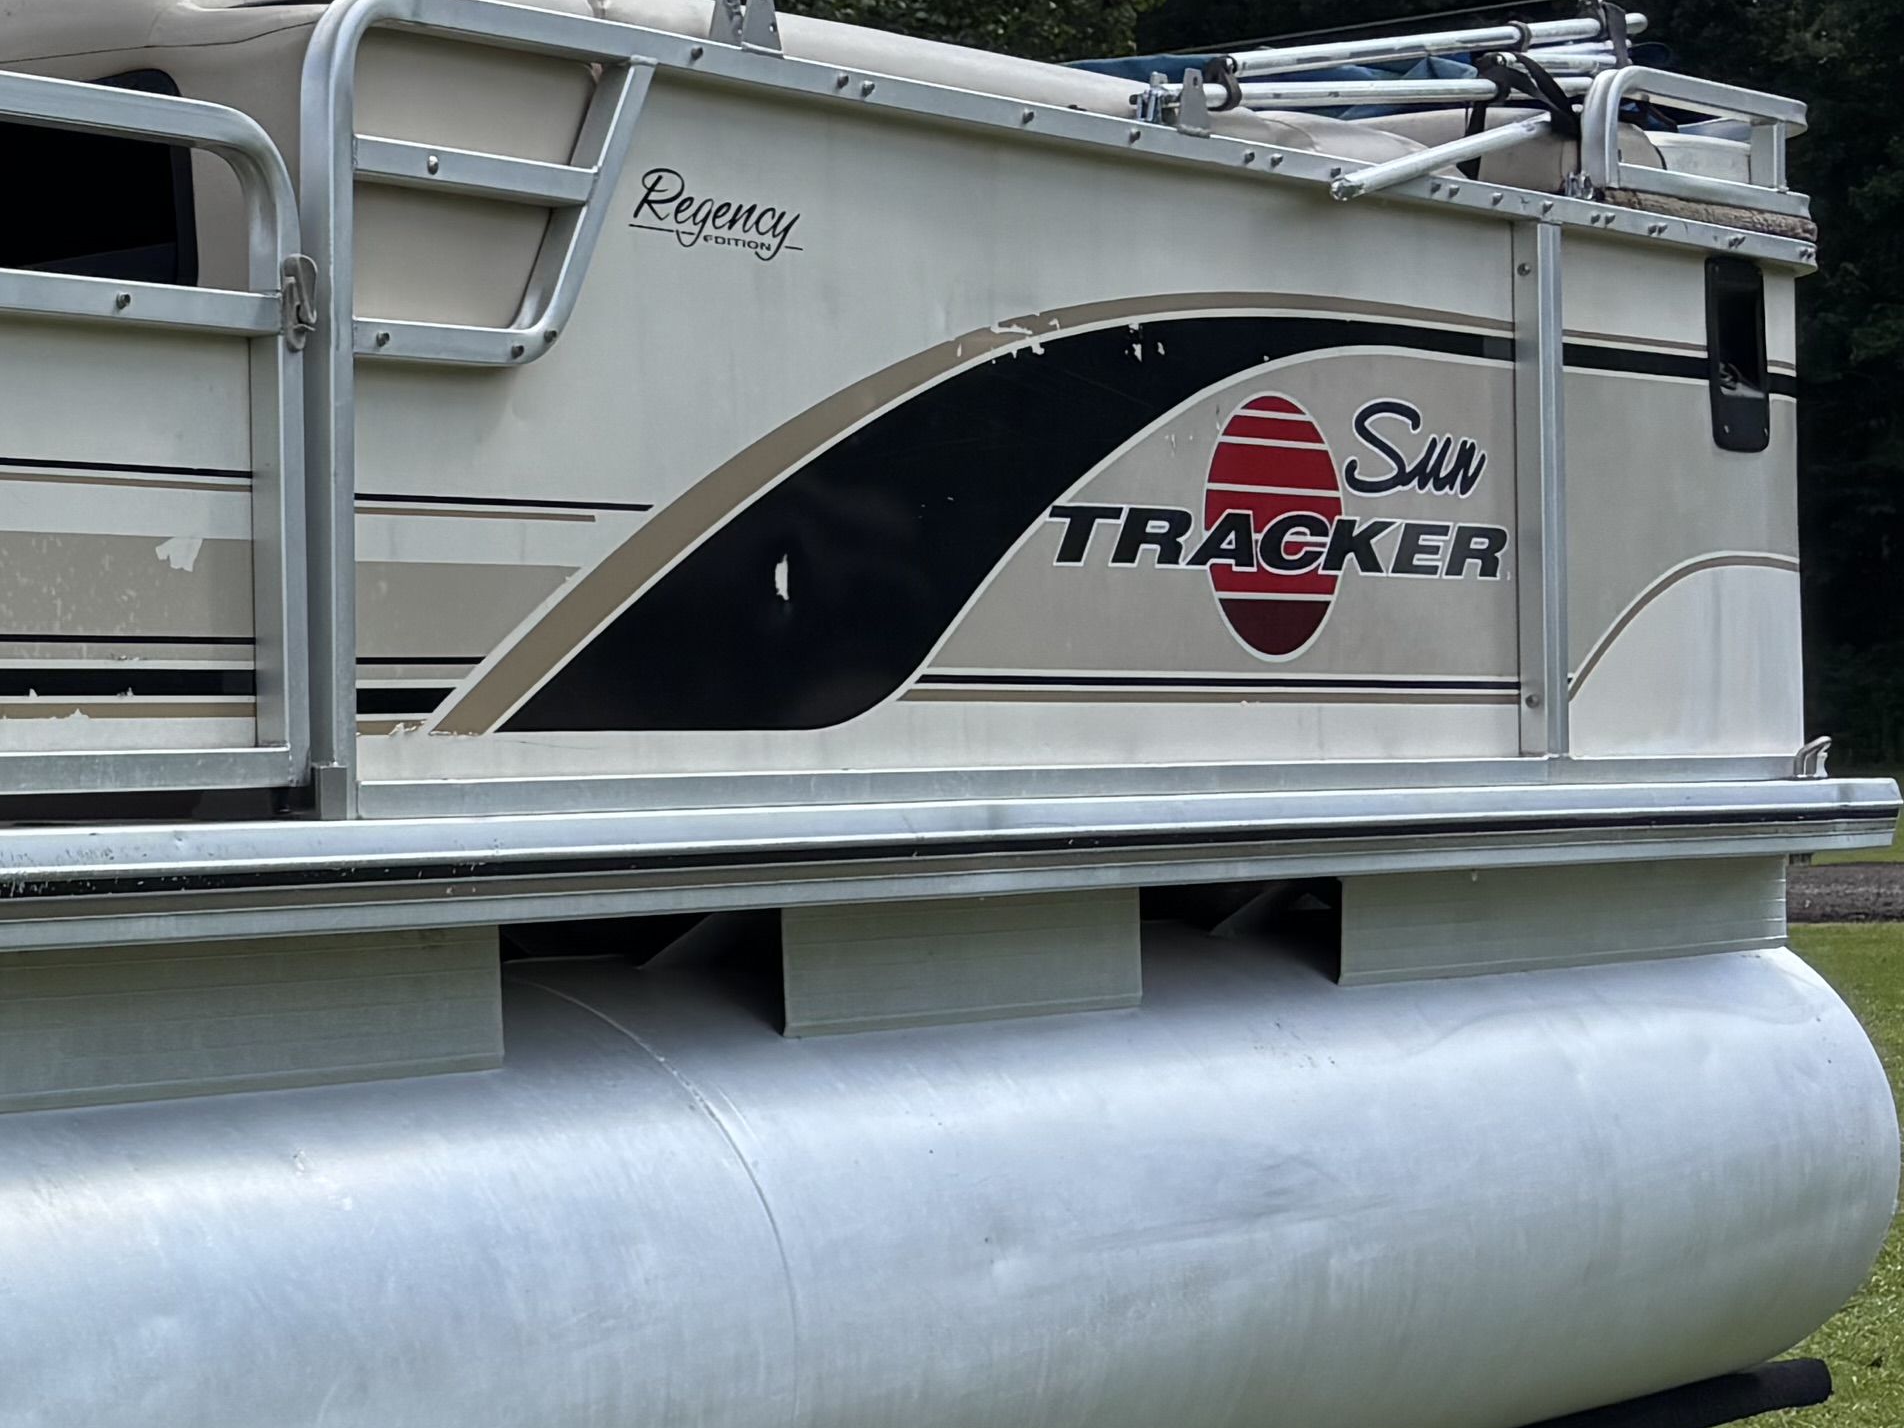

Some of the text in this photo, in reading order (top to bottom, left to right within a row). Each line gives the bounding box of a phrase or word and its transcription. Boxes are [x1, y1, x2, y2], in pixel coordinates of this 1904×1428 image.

[633, 167, 801, 262] Regency
[703, 234, 772, 253] EDITION
[1342, 397, 1489, 499] Sun
[1044, 502, 1511, 582] TRACKER
